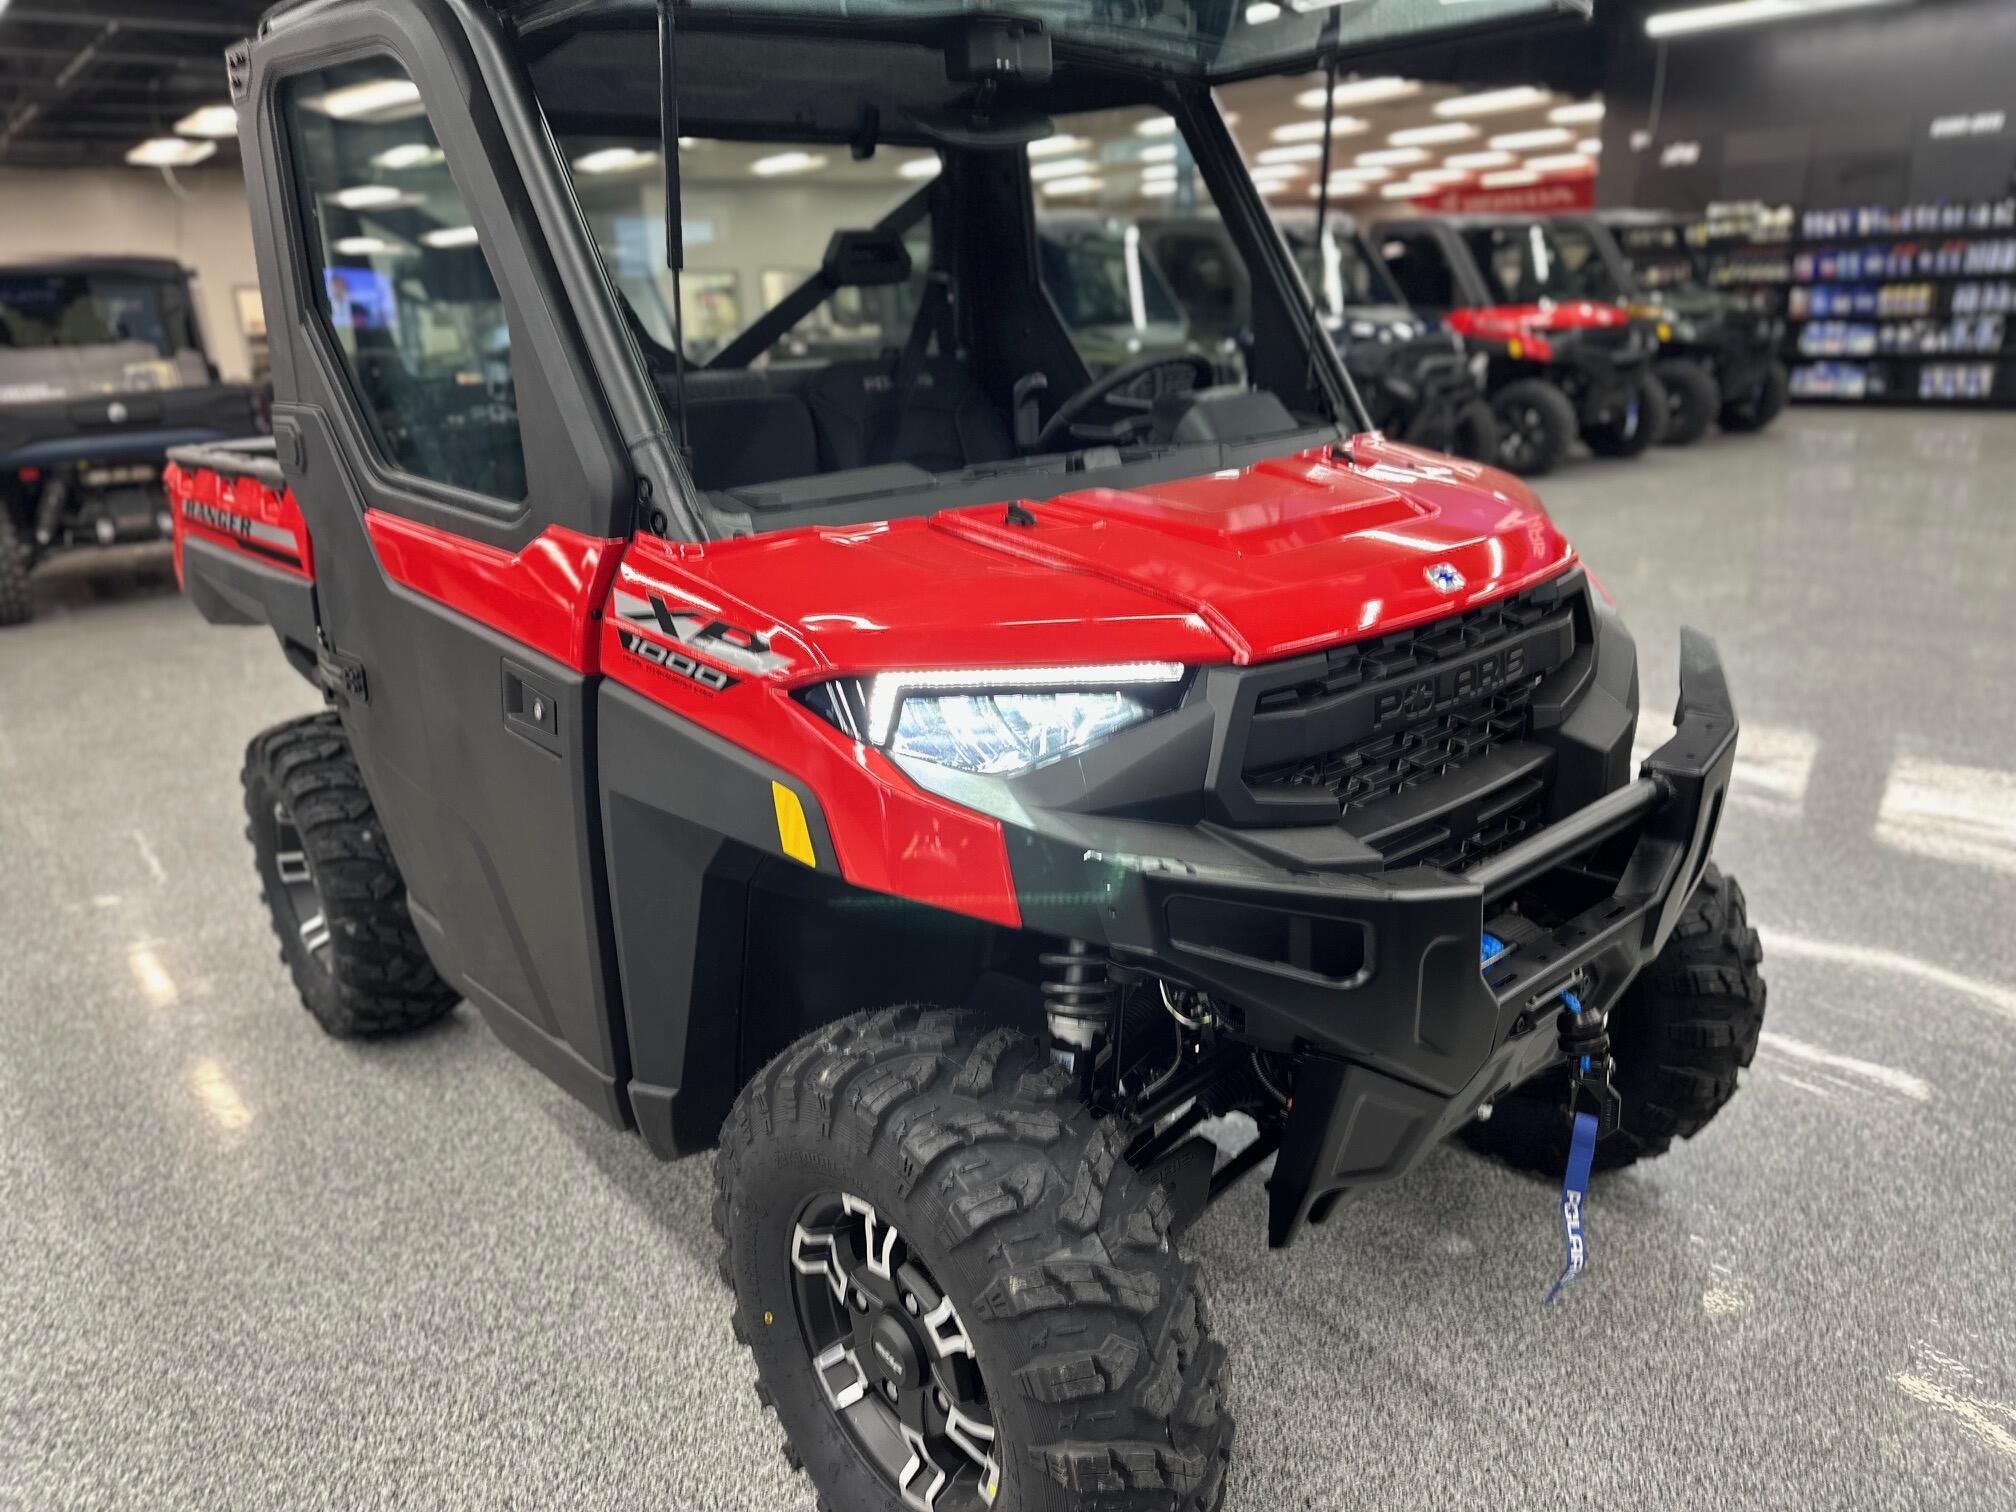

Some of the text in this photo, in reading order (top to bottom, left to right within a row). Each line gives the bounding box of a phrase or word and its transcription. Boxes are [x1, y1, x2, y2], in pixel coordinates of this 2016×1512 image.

[184, 498, 252, 537] RANGER
[629, 633, 728, 691] 1000
[1374, 647, 1525, 728] POLARIS
[1562, 1189, 1584, 1283] POLAR
